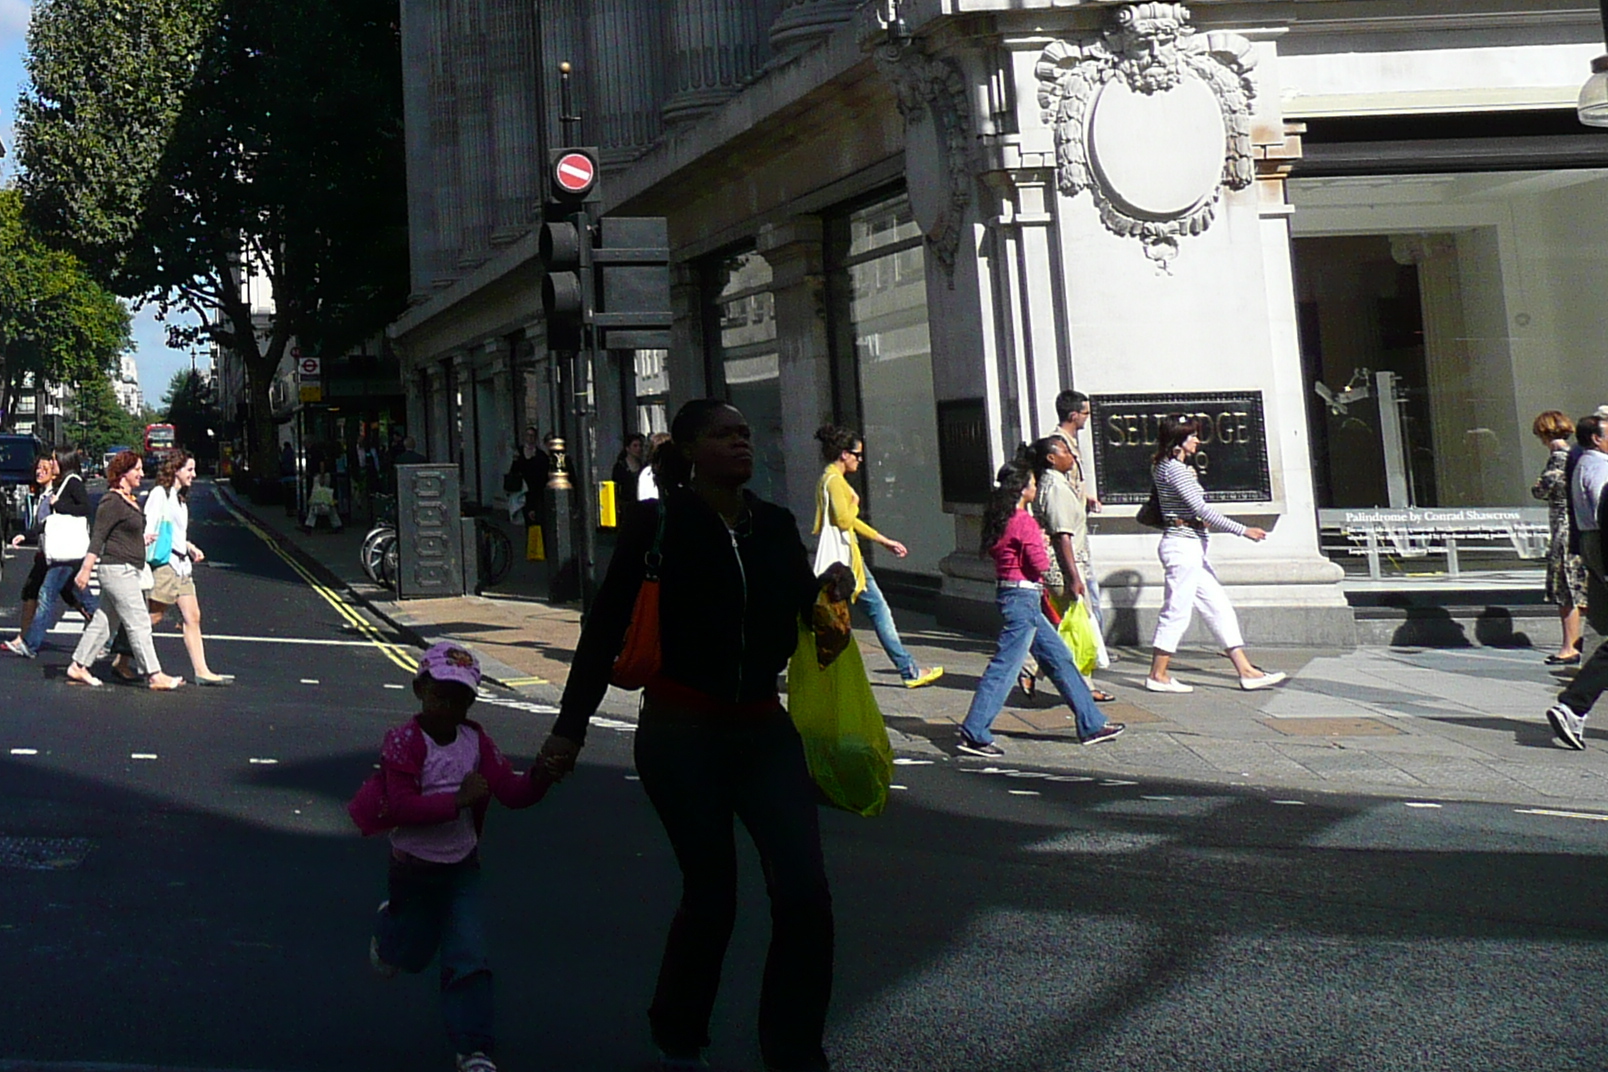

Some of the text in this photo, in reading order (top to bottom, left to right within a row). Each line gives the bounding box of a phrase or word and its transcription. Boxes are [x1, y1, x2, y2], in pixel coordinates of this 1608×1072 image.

[1107, 412, 1251, 447] SELDGE
[1345, 510, 1520, 524] Palindrome by Conrad Shawcross
